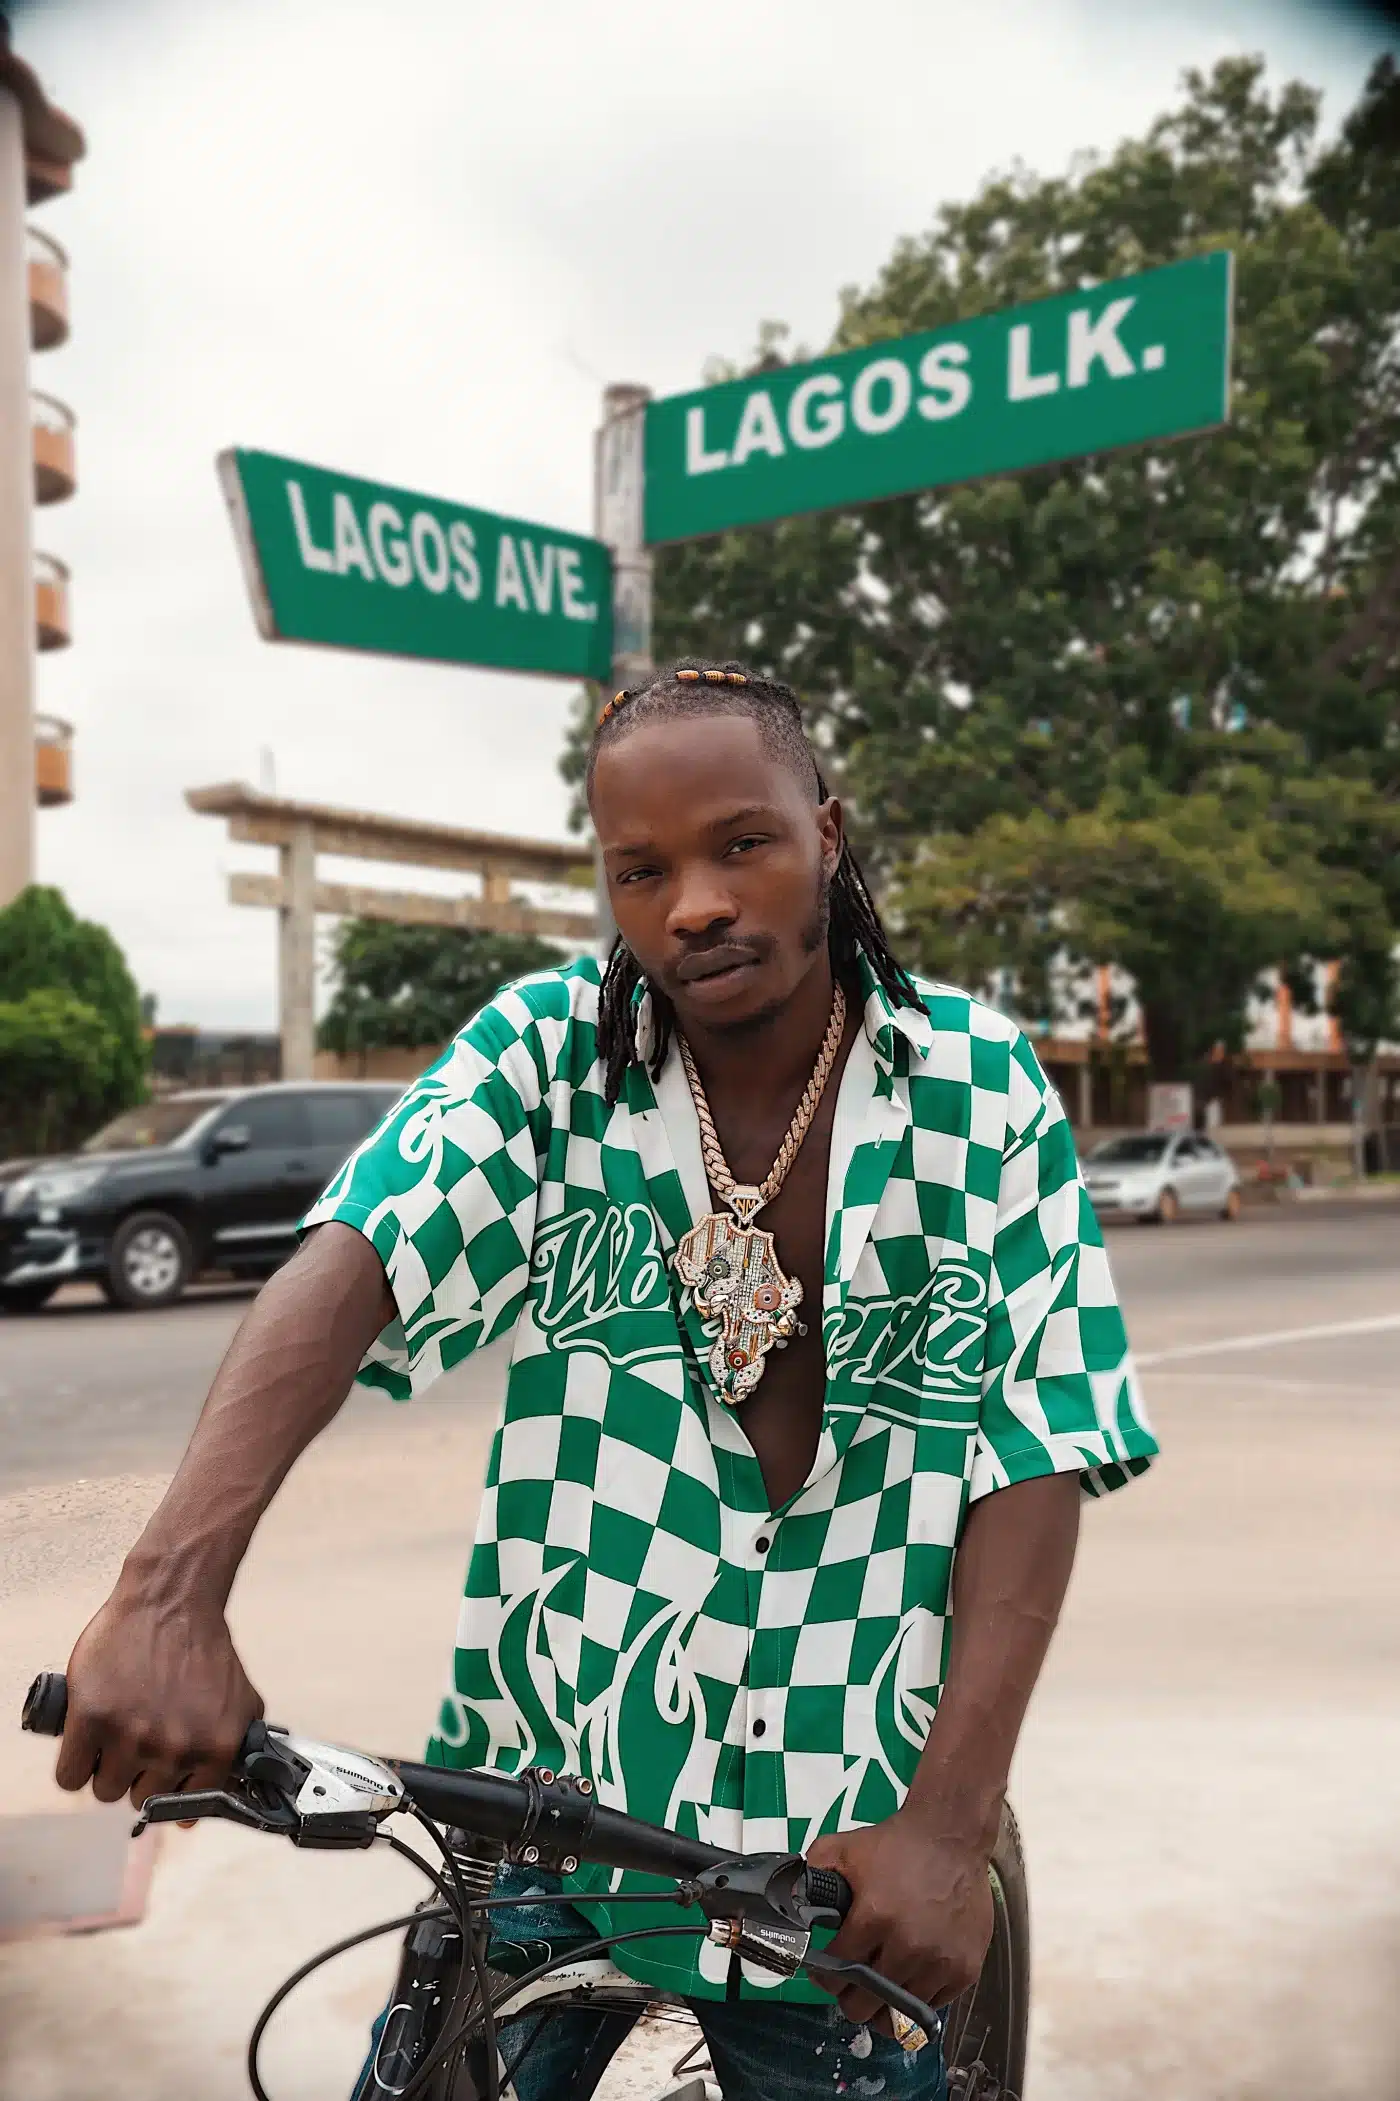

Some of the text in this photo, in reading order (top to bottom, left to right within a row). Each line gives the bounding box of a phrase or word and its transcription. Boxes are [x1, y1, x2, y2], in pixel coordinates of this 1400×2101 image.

[684, 297, 1166, 477] LAGOS LK.
[285, 480, 598, 622] LAGOS AVE.
[335, 1765, 384, 1791] SHIMANO
[760, 1928, 797, 1944] SHIMANO
